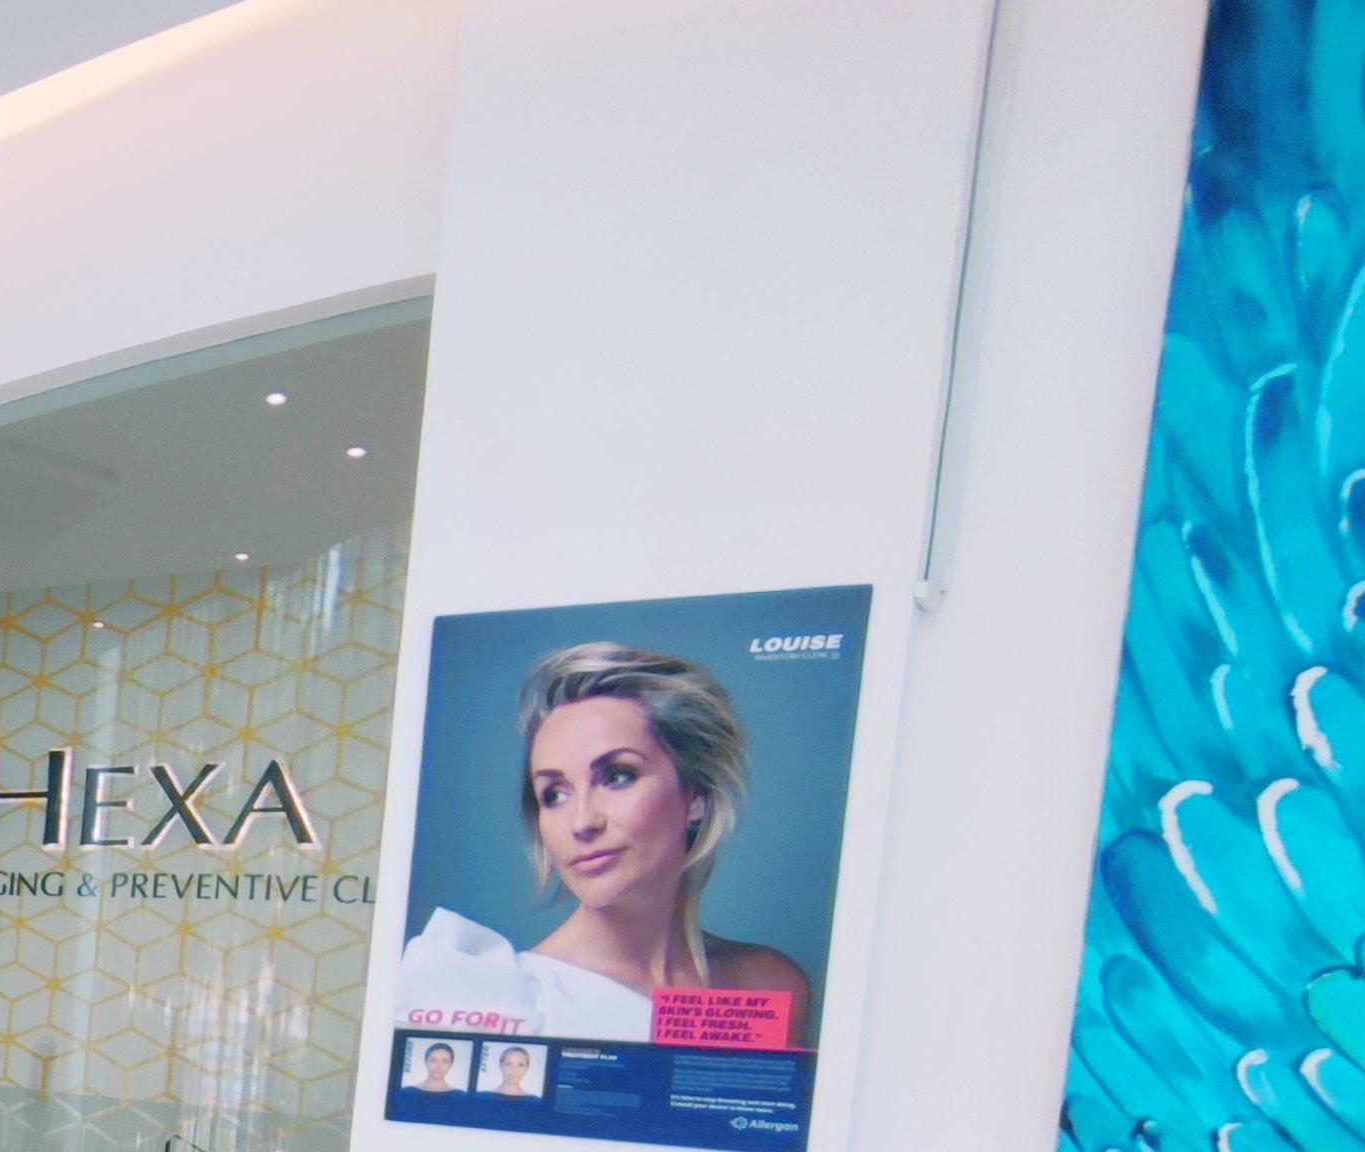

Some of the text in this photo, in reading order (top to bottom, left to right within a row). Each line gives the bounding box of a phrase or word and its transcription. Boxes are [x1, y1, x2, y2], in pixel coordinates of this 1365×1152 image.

[749, 634, 844, 653] LOUISE
[77, 873, 98, 897] &
[111, 872, 319, 902] PREVENTIVE
[671, 995, 703, 1005] FEEL
[709, 996, 742, 1006] LIKE
[746, 997, 769, 1007] MY
[659, 1006, 779, 1020] SKIN'S GLOWING.
[408, 1008, 527, 1035] GO FOR IT
[665, 1018, 696, 1028] FEEL
[701, 1019, 752, 1030] FRESH.
[664, 1029, 696, 1039] FEEL
[749, 1119, 799, 1132] Allergan
